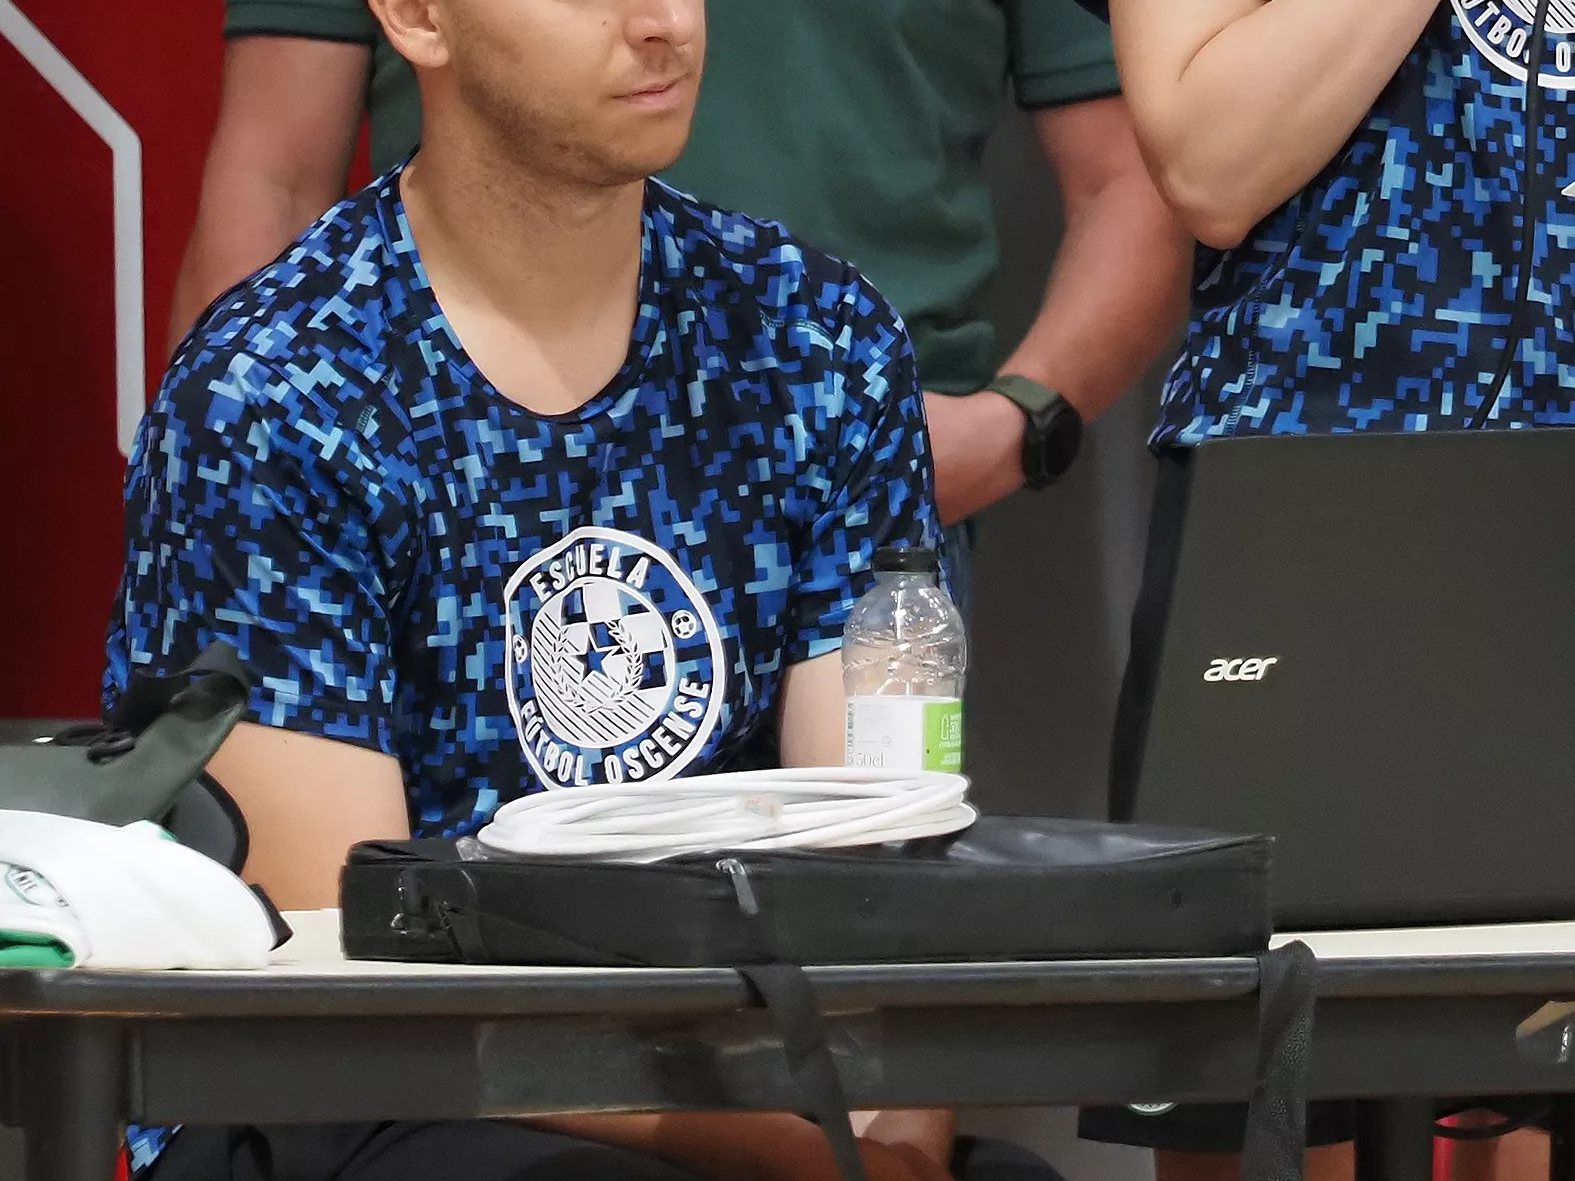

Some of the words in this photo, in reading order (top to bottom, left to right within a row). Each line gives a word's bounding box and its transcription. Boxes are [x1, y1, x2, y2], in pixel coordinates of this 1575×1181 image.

[529, 543, 651, 603] ESCUELA
[1203, 657, 1278, 682] acer
[603, 677, 710, 785] OSCENSE
